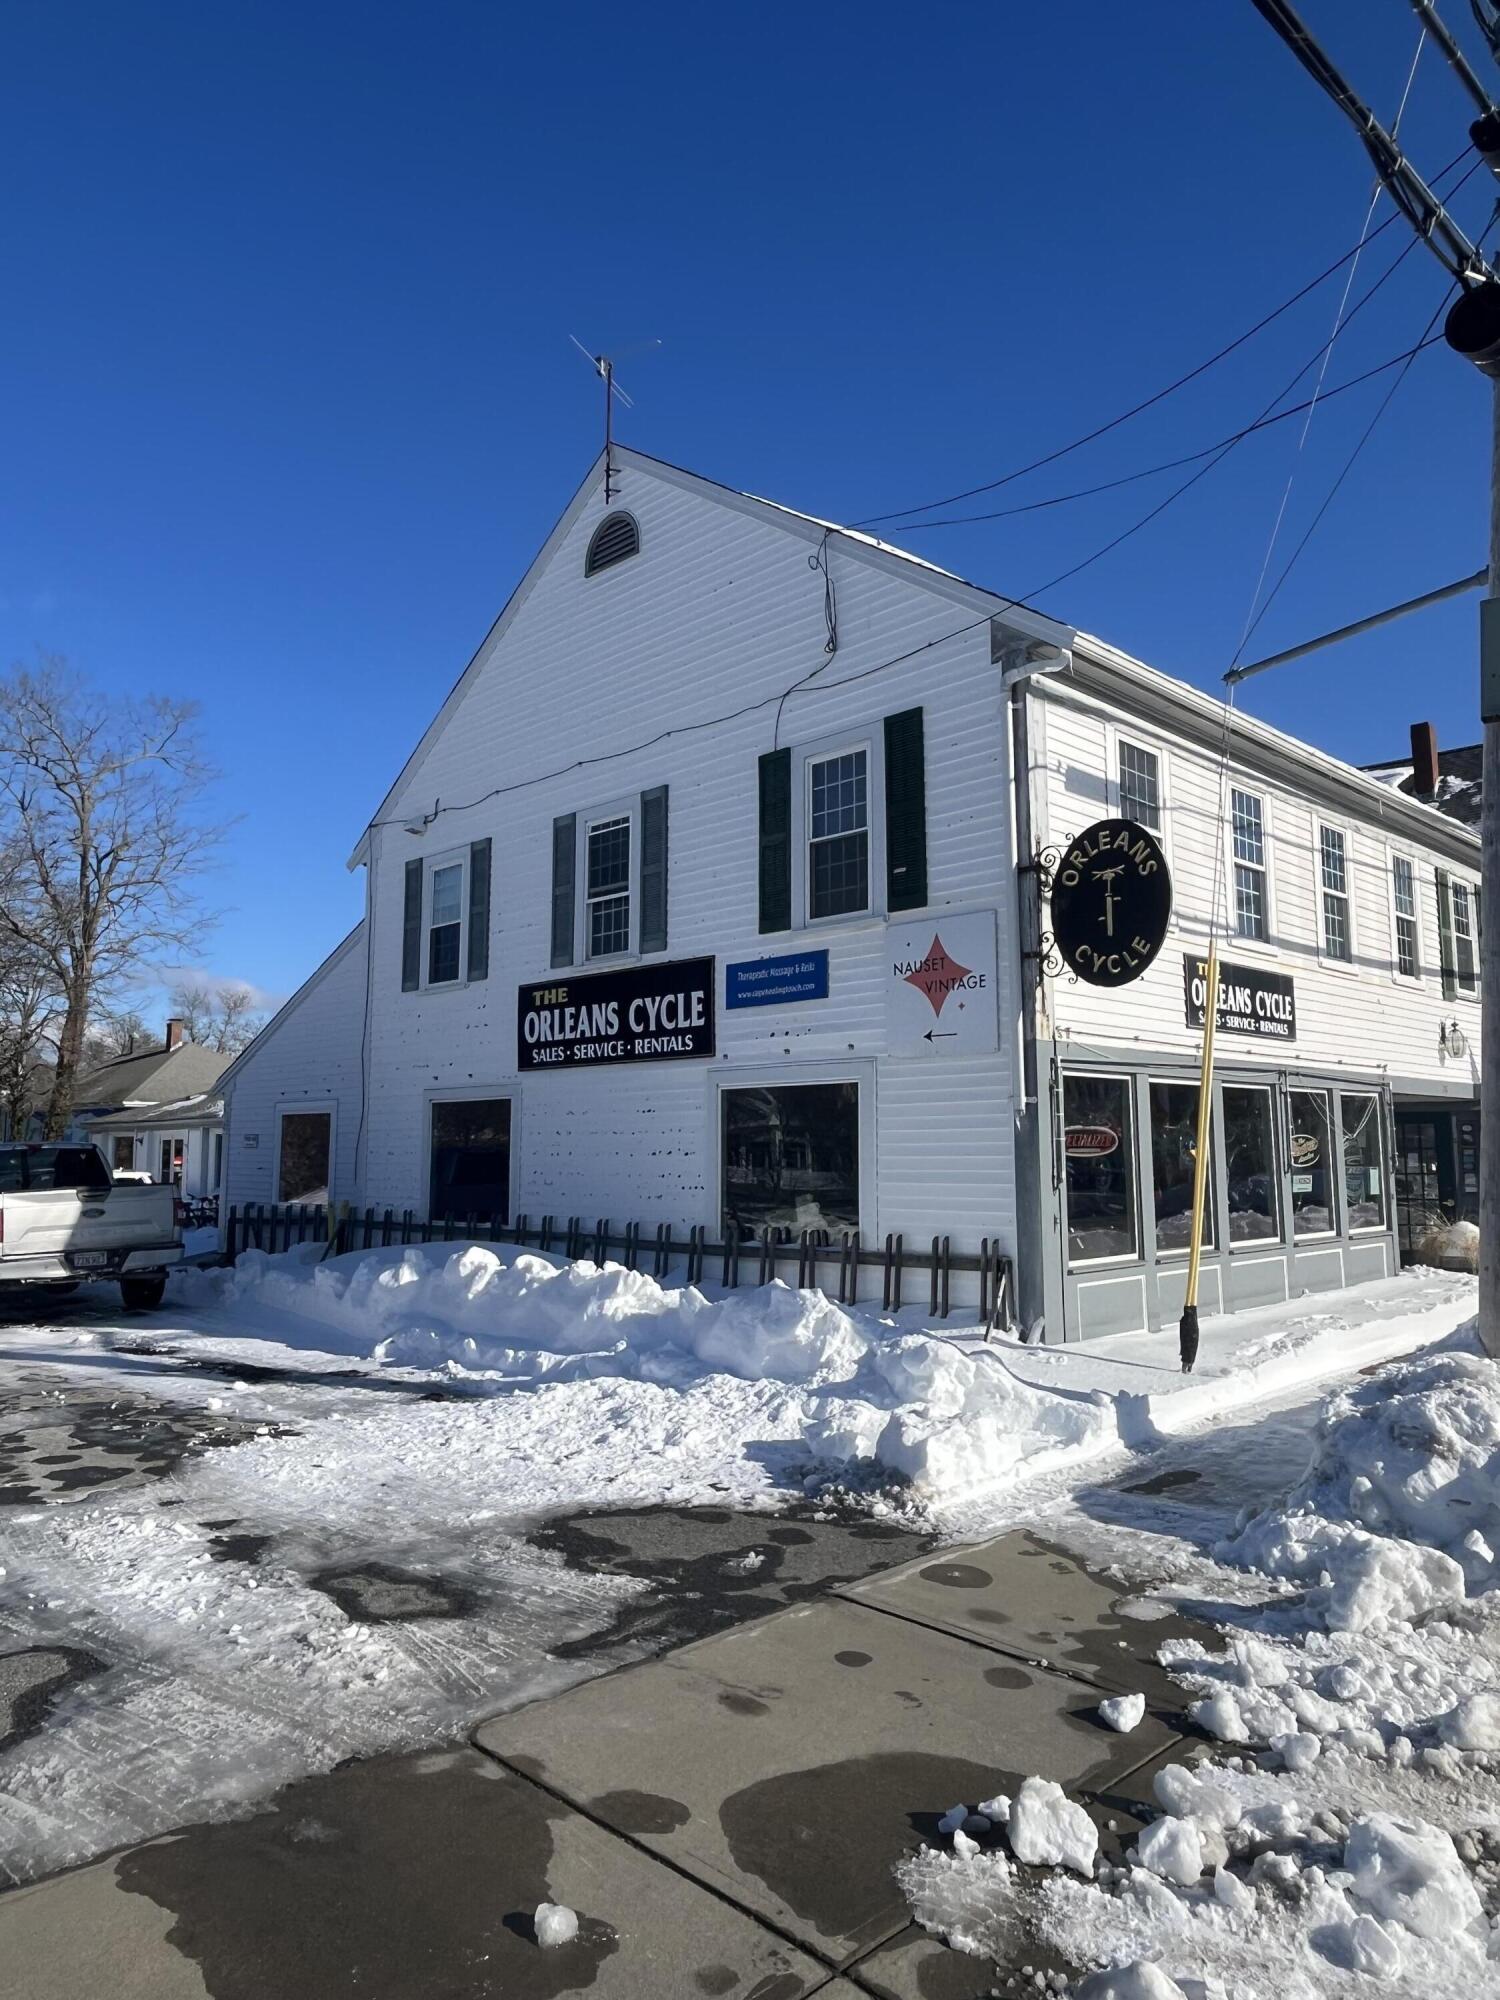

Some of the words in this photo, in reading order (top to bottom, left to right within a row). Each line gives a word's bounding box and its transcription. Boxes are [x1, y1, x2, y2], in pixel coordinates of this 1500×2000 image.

[1061, 830, 1158, 887] ORLEANS
[1075, 935, 1151, 973] CYCLE
[769, 966, 794, 977] Massage
[893, 957, 945, 976] NAUSET
[925, 974, 986, 993] VINTAGE
[532, 987, 569, 1007] THE
[1255, 990, 1293, 1021] CYCLE
[524, 1001, 620, 1044] ORLEANS
[628, 990, 706, 1033] CYCLE
[1226, 1015, 1256, 1031] SERVICE
[1260, 1020, 1289, 1035] RENTALS
[532, 1046, 565, 1063] SALES
[574, 1040, 625, 1060] SERVICE
[634, 1034, 694, 1054] RENTALS
